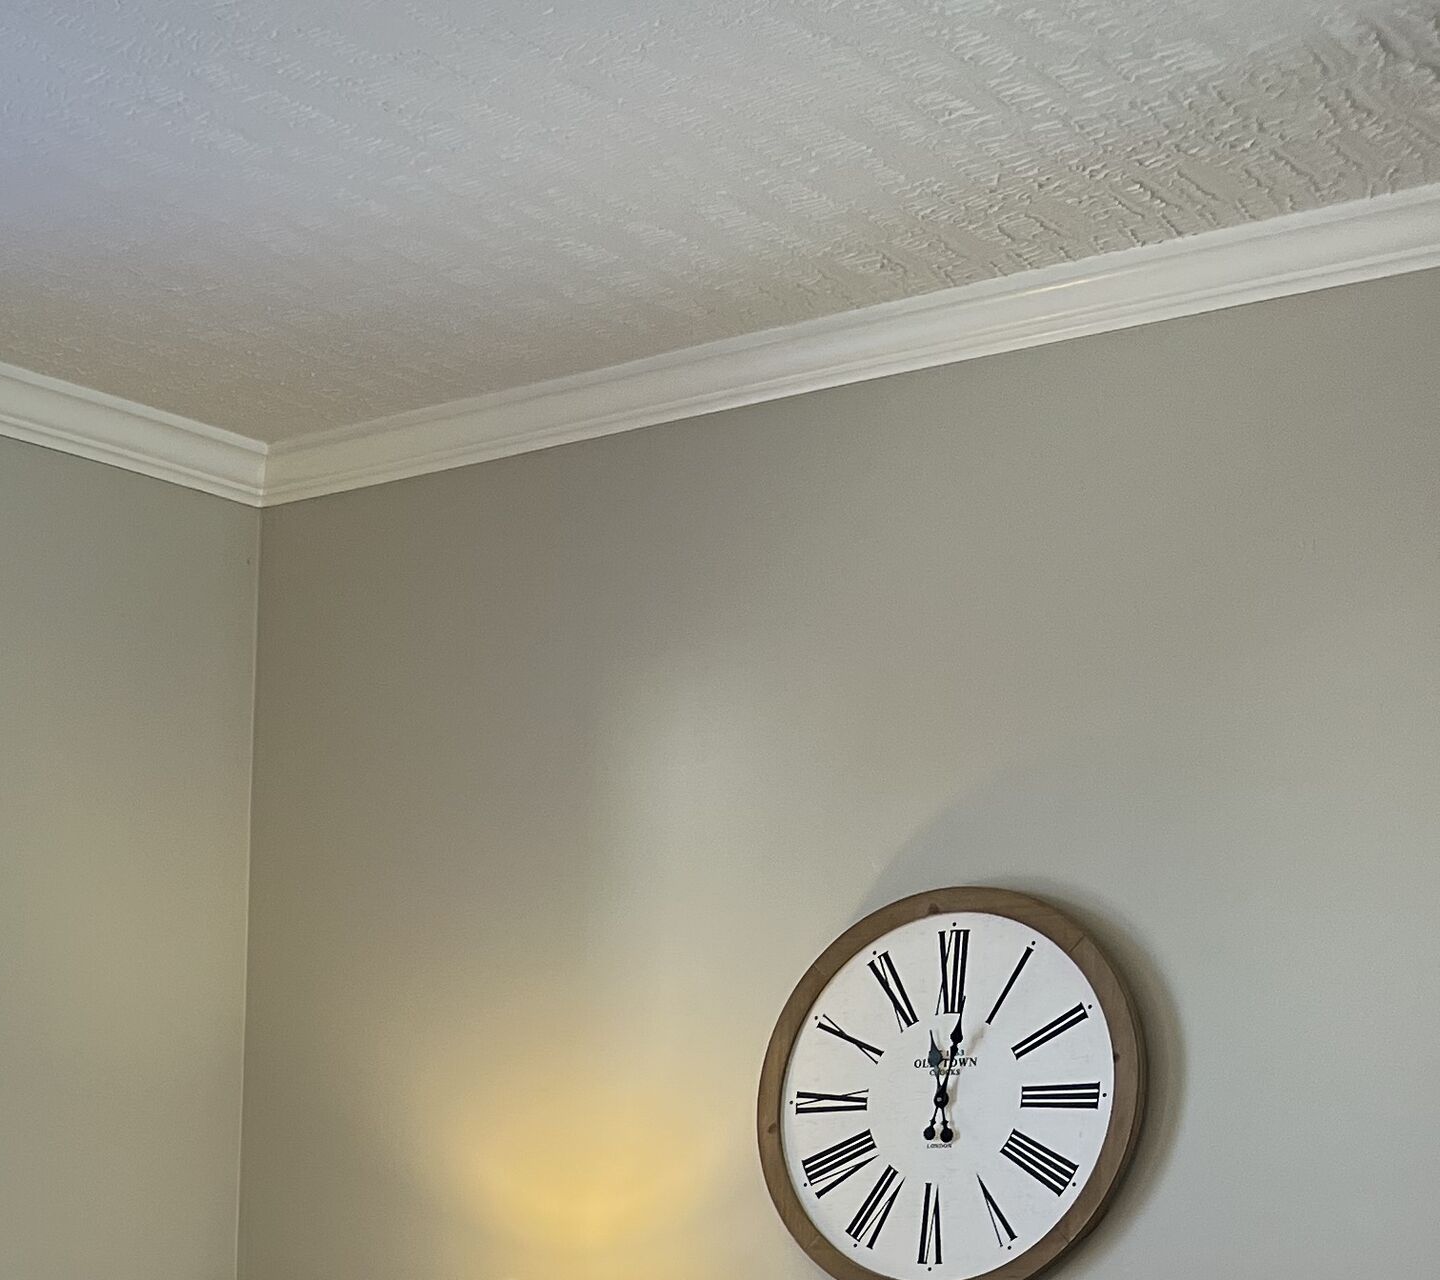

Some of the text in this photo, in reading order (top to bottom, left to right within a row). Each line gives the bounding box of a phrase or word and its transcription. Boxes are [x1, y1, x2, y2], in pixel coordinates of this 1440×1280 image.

[866, 950, 920, 1034] XI
[935, 929, 970, 1015] XII
[816, 1013, 885, 1065] X
[1011, 1002, 1089, 1060] II
[795, 1088, 870, 1115] IX
[929, 1068, 961, 1076] COCKS
[1020, 1081, 1101, 1110] III
[801, 1128, 880, 1199] VIII
[845, 1164, 907, 1249] VII
[917, 1182, 943, 1265] VI
[976, 1172, 1018, 1248] V
